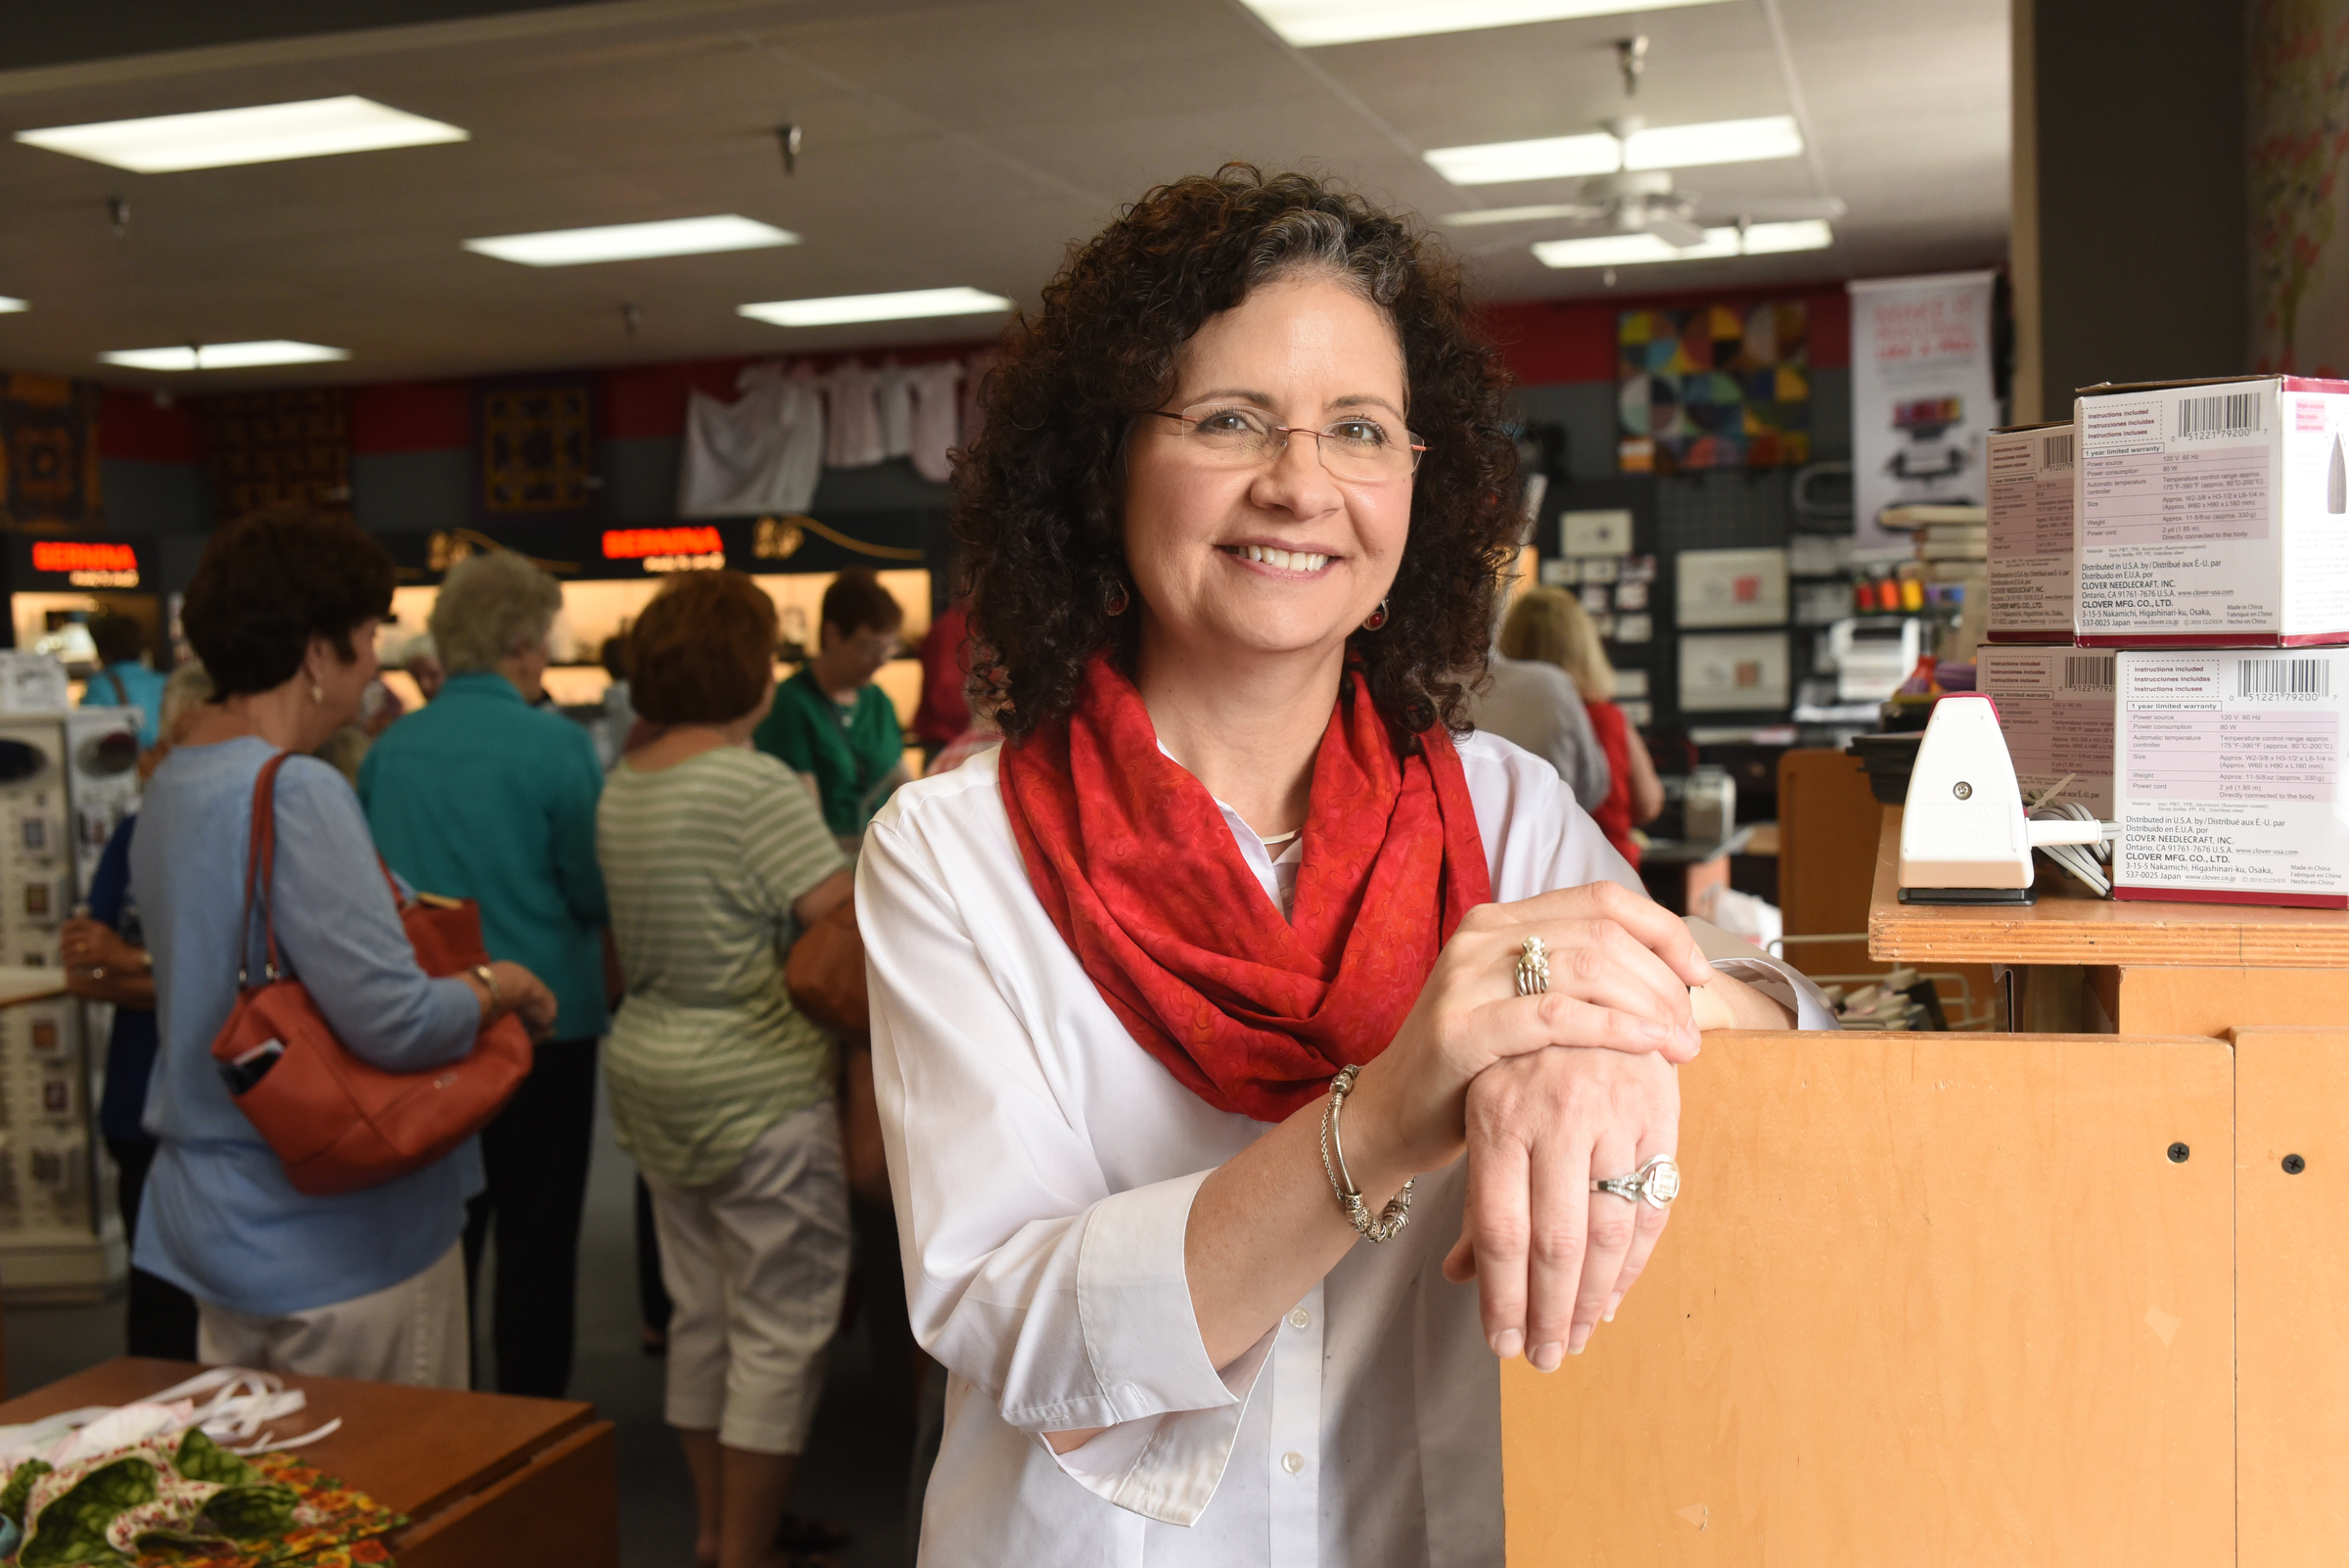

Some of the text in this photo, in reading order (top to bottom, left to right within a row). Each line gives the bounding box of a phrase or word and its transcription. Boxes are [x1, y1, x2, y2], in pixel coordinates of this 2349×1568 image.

[2088, 421, 2127, 429] Instrucciones
[2188, 431, 2215, 441] 51221
[2221, 428, 2250, 438] 79200
[2131, 446, 2160, 454] warranty
[2105, 468, 2139, 476] consumption
[2195, 558, 2209, 567] É.-U.
[2110, 581, 2159, 590] NEEDLECRAFT,
[2139, 609, 2188, 618] Higashinari-ku,
[2256, 817, 2272, 826] É.-U.
[2158, 835, 2215, 844] NEEDLECRAFT,
[2126, 844, 2154, 852] Ontario,
[2150, 863, 2190, 872] Nakamichi,
[2192, 864, 2247, 874] Higashinari-ku,
[2248, 866, 2273, 874] Osaka,
[2160, 872, 2181, 880] Japan
